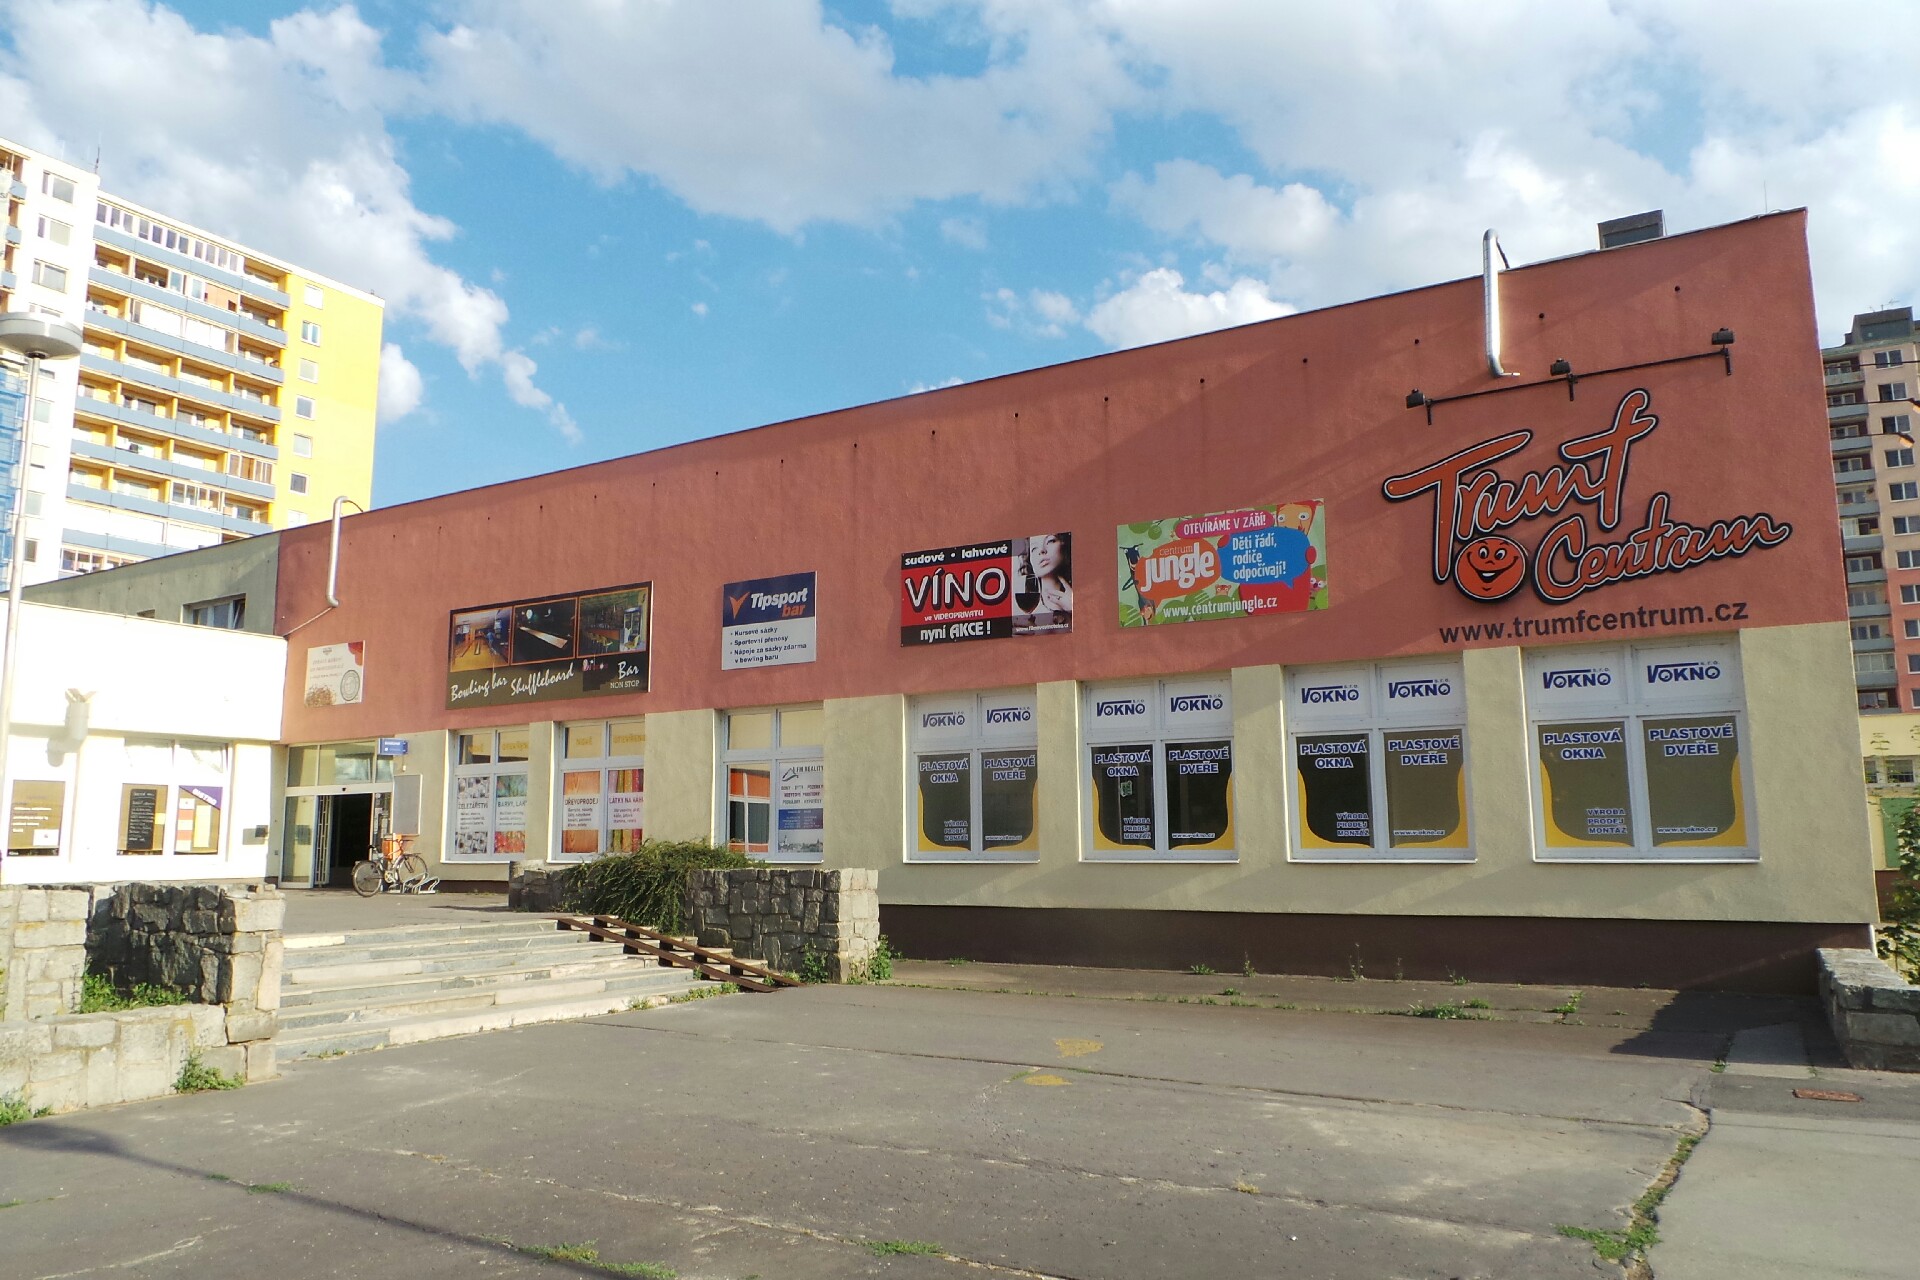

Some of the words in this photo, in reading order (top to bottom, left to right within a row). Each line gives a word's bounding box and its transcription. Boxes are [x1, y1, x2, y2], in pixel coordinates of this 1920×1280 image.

[1383, 389, 1658, 584] Trumf
[1183, 517, 1231, 536] OTEVÍRÁME
[1233, 517, 1240, 529] V
[1243, 511, 1266, 528] ZÁŘÍ!
[1232, 534, 1252, 551] Děti
[1255, 532, 1277, 548] řádí,
[1532, 492, 1792, 605] Centrum
[905, 552, 945, 566] sudové
[961, 543, 1008, 559] lahvové
[1159, 545, 1194, 556] centrum
[1232, 551, 1262, 565] rodiče
[1140, 543, 1215, 592] jungle
[1233, 561, 1286, 581] odpočívají!
[905, 567, 1008, 611] VÍNO
[751, 587, 808, 610] Tipsport
[782, 604, 806, 617] bar
[1163, 596, 1278, 618] www.centrumjungle.cz
[1440, 602, 1749, 644] www.trumfcentrum.cz
[920, 625, 946, 643] nyní
[618, 661, 640, 680] Bar
[450, 679, 489, 702] Bowling
[491, 672, 508, 690] bar
[510, 662, 574, 696] Shuffleboard
[610, 681, 624, 689] NON
[624, 679, 640, 688] STOP
[1543, 728, 1623, 746] PLASTOVÁ
[1649, 723, 1734, 742] PLASTOVÉ
[1301, 739, 1367, 755] PLASTOVÁ
[1388, 735, 1461, 752] PLASTOVÉ
[1664, 741, 1719, 757] DVEŘE
[984, 755, 1036, 768] PLASTOVÉ
[1095, 750, 1151, 764] PLASTOVÁ
[1168, 746, 1230, 761] PLASTOVÉ
[1401, 751, 1448, 766] DVEŘE
[1561, 747, 1606, 761] OKNA
[920, 758, 969, 771] PLASTOVÁ
[1180, 760, 1219, 775] DVEŘE
[1315, 756, 1353, 769] OKNA
[930, 772, 959, 783] OKNA
[993, 768, 1026, 780] DVEŘE
[1106, 765, 1139, 778] OKNA
[1336, 811, 1369, 820] VÝROBA
[1586, 807, 1626, 816] VÝROBA
[1587, 817, 1624, 826] PRODEJ
[1657, 825, 1718, 834] www.v-okno.cz
